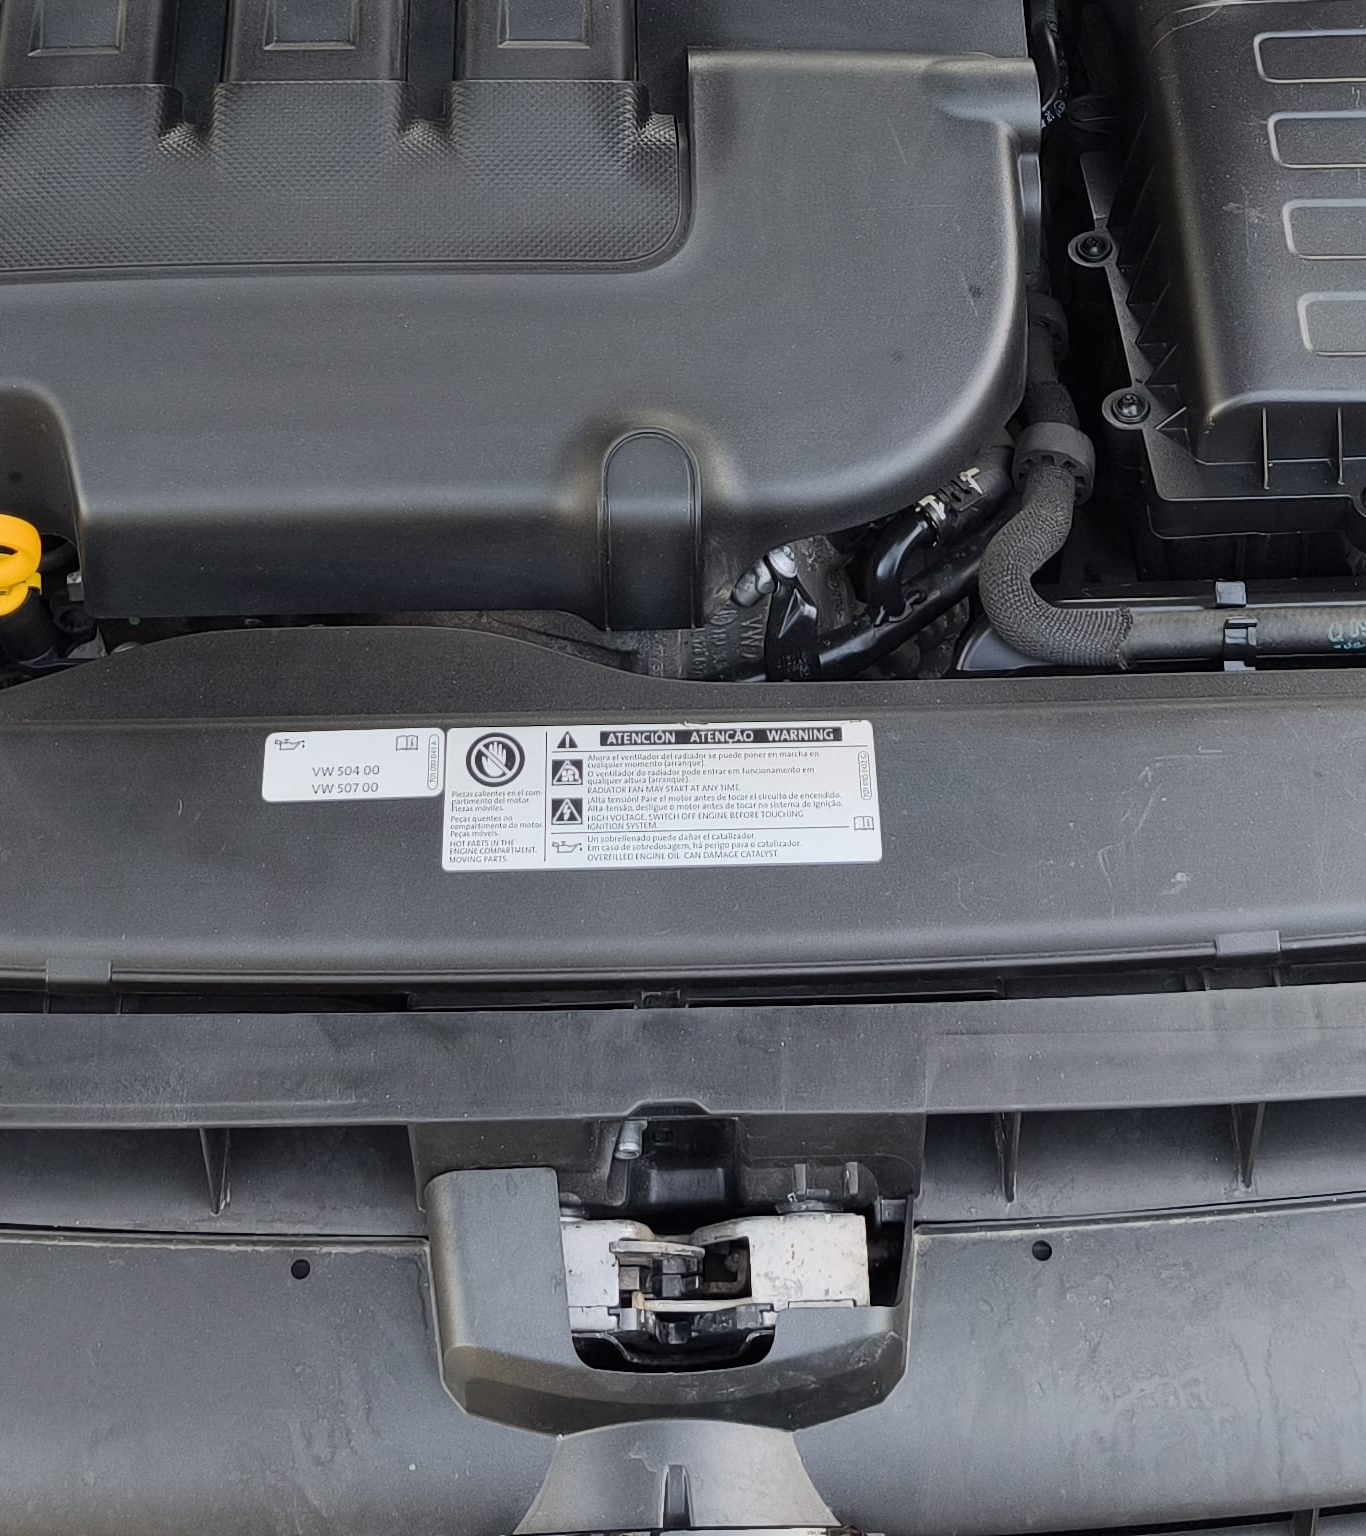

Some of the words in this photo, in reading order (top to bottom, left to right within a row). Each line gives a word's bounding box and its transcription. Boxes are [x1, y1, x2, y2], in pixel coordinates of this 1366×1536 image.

[607, 729, 676, 745] ATENCIÓN
[690, 728, 754, 744] ATENÇÃO
[766, 728, 834, 742] WARNING
[587, 754, 611, 762] Ahora
[620, 753, 661, 761] ventilador
[661, 752, 673, 760] del
[674, 752, 707, 760] radiador
[718, 751, 743, 761] puede
[743, 752, 767, 761] poner
[779, 750, 808, 758] marcha
[587, 760, 624, 771] cualquier
[624, 759, 663, 768] momento
[312, 766, 335, 777] VW
[337, 765, 360, 776] 504
[363, 765, 380, 776] 00
[595, 769, 635, 778] ventilador
[636, 769, 646, 777] do
[647, 768, 681, 777] radiador
[681, 768, 701, 778] pode
[702, 767, 727, 776] entrar
[741, 766, 801, 775] funcionamento
[587, 776, 625, 786] qualquer
[625, 776, 647, 784] altura
[311, 783, 334, 794] VW
[337, 783, 359, 793] 507
[362, 782, 379, 793] 00
[587, 785, 627, 794] RADIATOR
[628, 785, 644, 793] FAN
[645, 785, 664, 793] MAY
[665, 784, 690, 792] START
[690, 784, 701, 792] AT
[701, 784, 718, 792] ANY
[451, 790, 474, 798] Piezas
[474, 789, 506, 797] calientes
[669, 794, 692, 803] motor
[693, 794, 715, 802] antes
[716, 794, 727, 802] de
[728, 793, 748, 801] tocar
[758, 793, 787, 801] circuito
[788, 792, 799, 800] de
[493, 796, 505, 804] del
[636, 803, 668, 813] desligue
[676, 803, 701, 811] motor
[702, 802, 724, 810] antes
[725, 802, 735, 810] de
[736, 802, 757, 810] tocar
[769, 801, 800, 809] sistema
[801, 800, 812, 808] de
[472, 814, 502, 824] quentes
[587, 814, 609, 823] HIGH
[648, 813, 681, 821] SWITCH
[681, 813, 697, 821] OFF
[697, 812, 728, 820] ENGINE
[729, 812, 759, 820] BEFORE
[761, 811, 804, 819] TOUCHING
[450, 821, 508, 832] compartimento
[508, 821, 519, 829] do
[587, 823, 624, 831] IGNITION
[449, 840, 465, 848] HOT
[467, 839, 490, 847] PARTS
[490, 839, 500, 847] IN
[500, 839, 515, 847] THE
[587, 835, 599, 843] Un
[600, 834, 651, 843] sobrellenado
[652, 834, 677, 844] puede
[449, 847, 478, 855] ENGINE
[587, 844, 600, 852] Em
[620, 843, 631, 851] de
[692, 842, 703, 850] há
[704, 842, 730, 852] perigo
[731, 843, 749, 851] para
[449, 855, 482, 864] MOVING
[587, 853, 634, 862] OVERFILLED
[635, 853, 666, 861] ENGINE
[683, 852, 702, 860] CAN
[703, 851, 739, 860] DAMAGE
